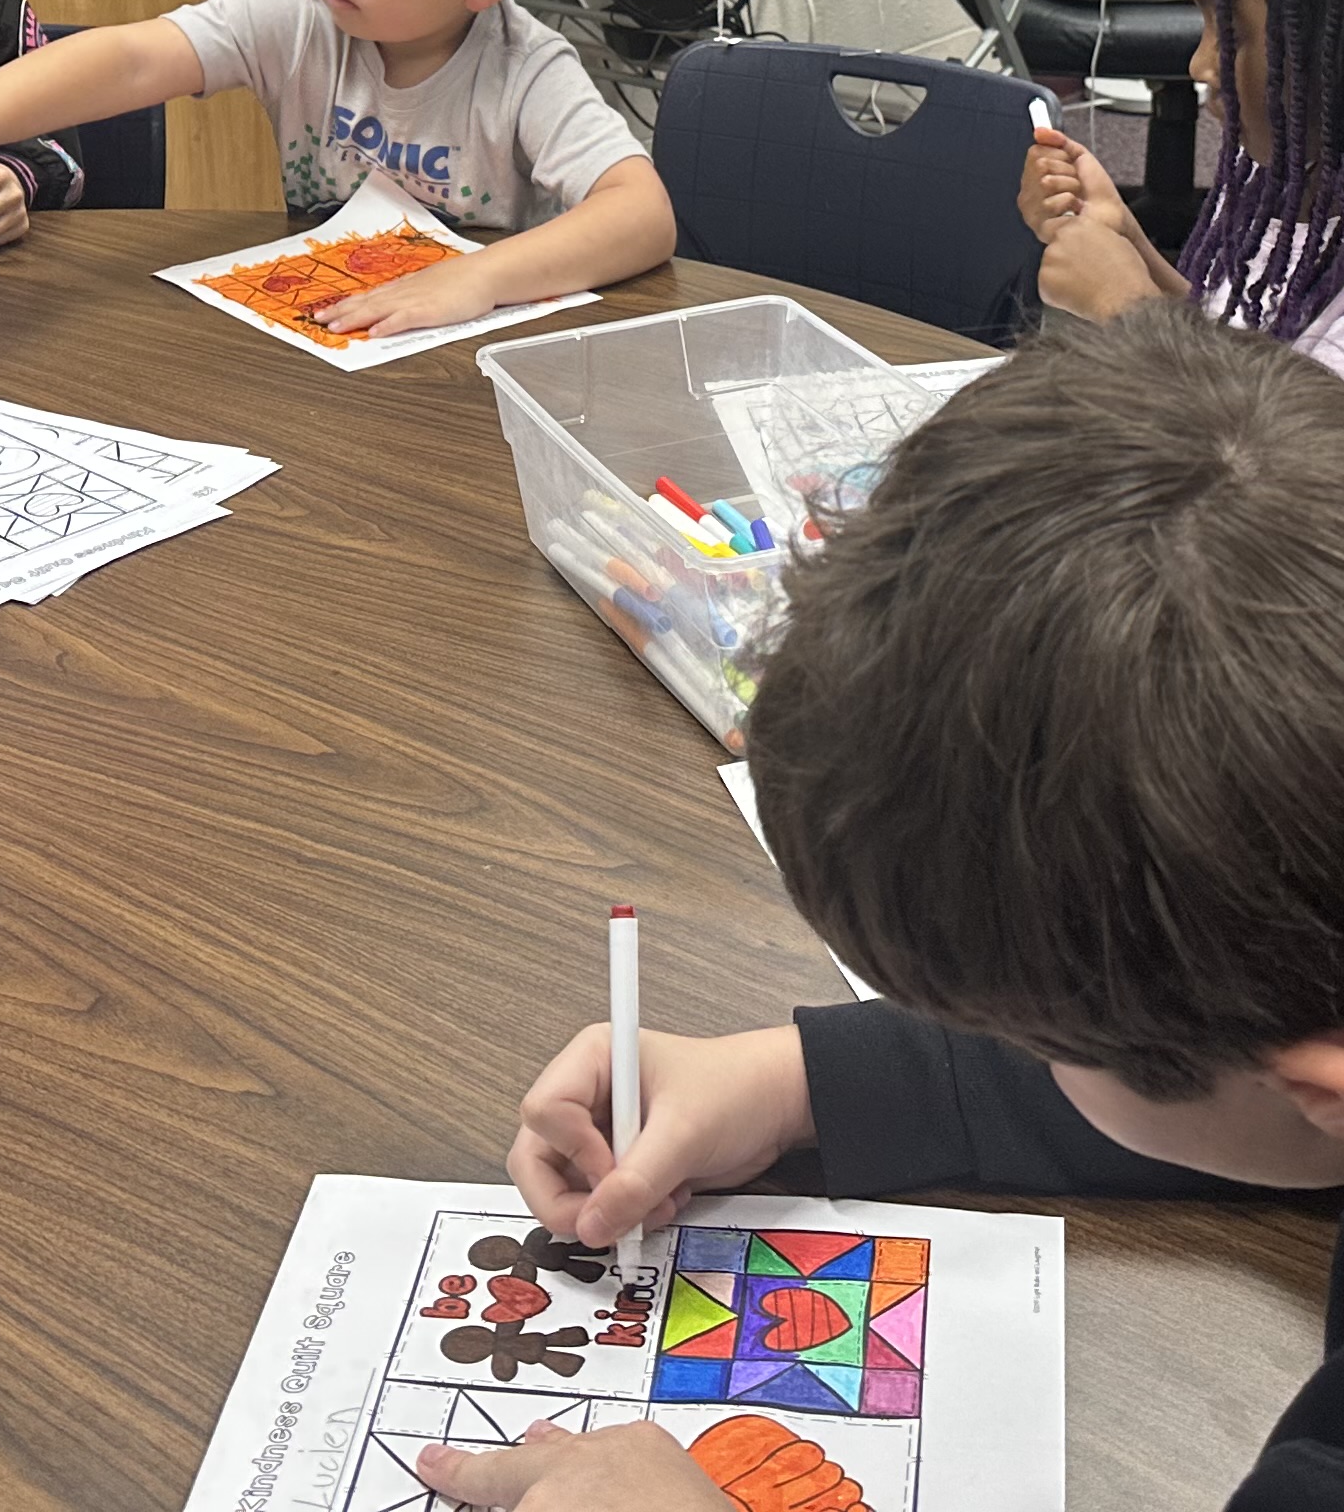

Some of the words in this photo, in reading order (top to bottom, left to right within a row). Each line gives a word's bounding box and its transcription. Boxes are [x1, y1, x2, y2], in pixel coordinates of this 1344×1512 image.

[333, 105, 451, 180] SONIC
[28, 557, 74, 578] Quilt
[74, 526, 156, 559] Kindness
[303, 1250, 356, 1330] Square
[419, 1273, 478, 1320] be
[281, 1337, 326, 1394] Quilt
[234, 1400, 303, 1512] Kindness
